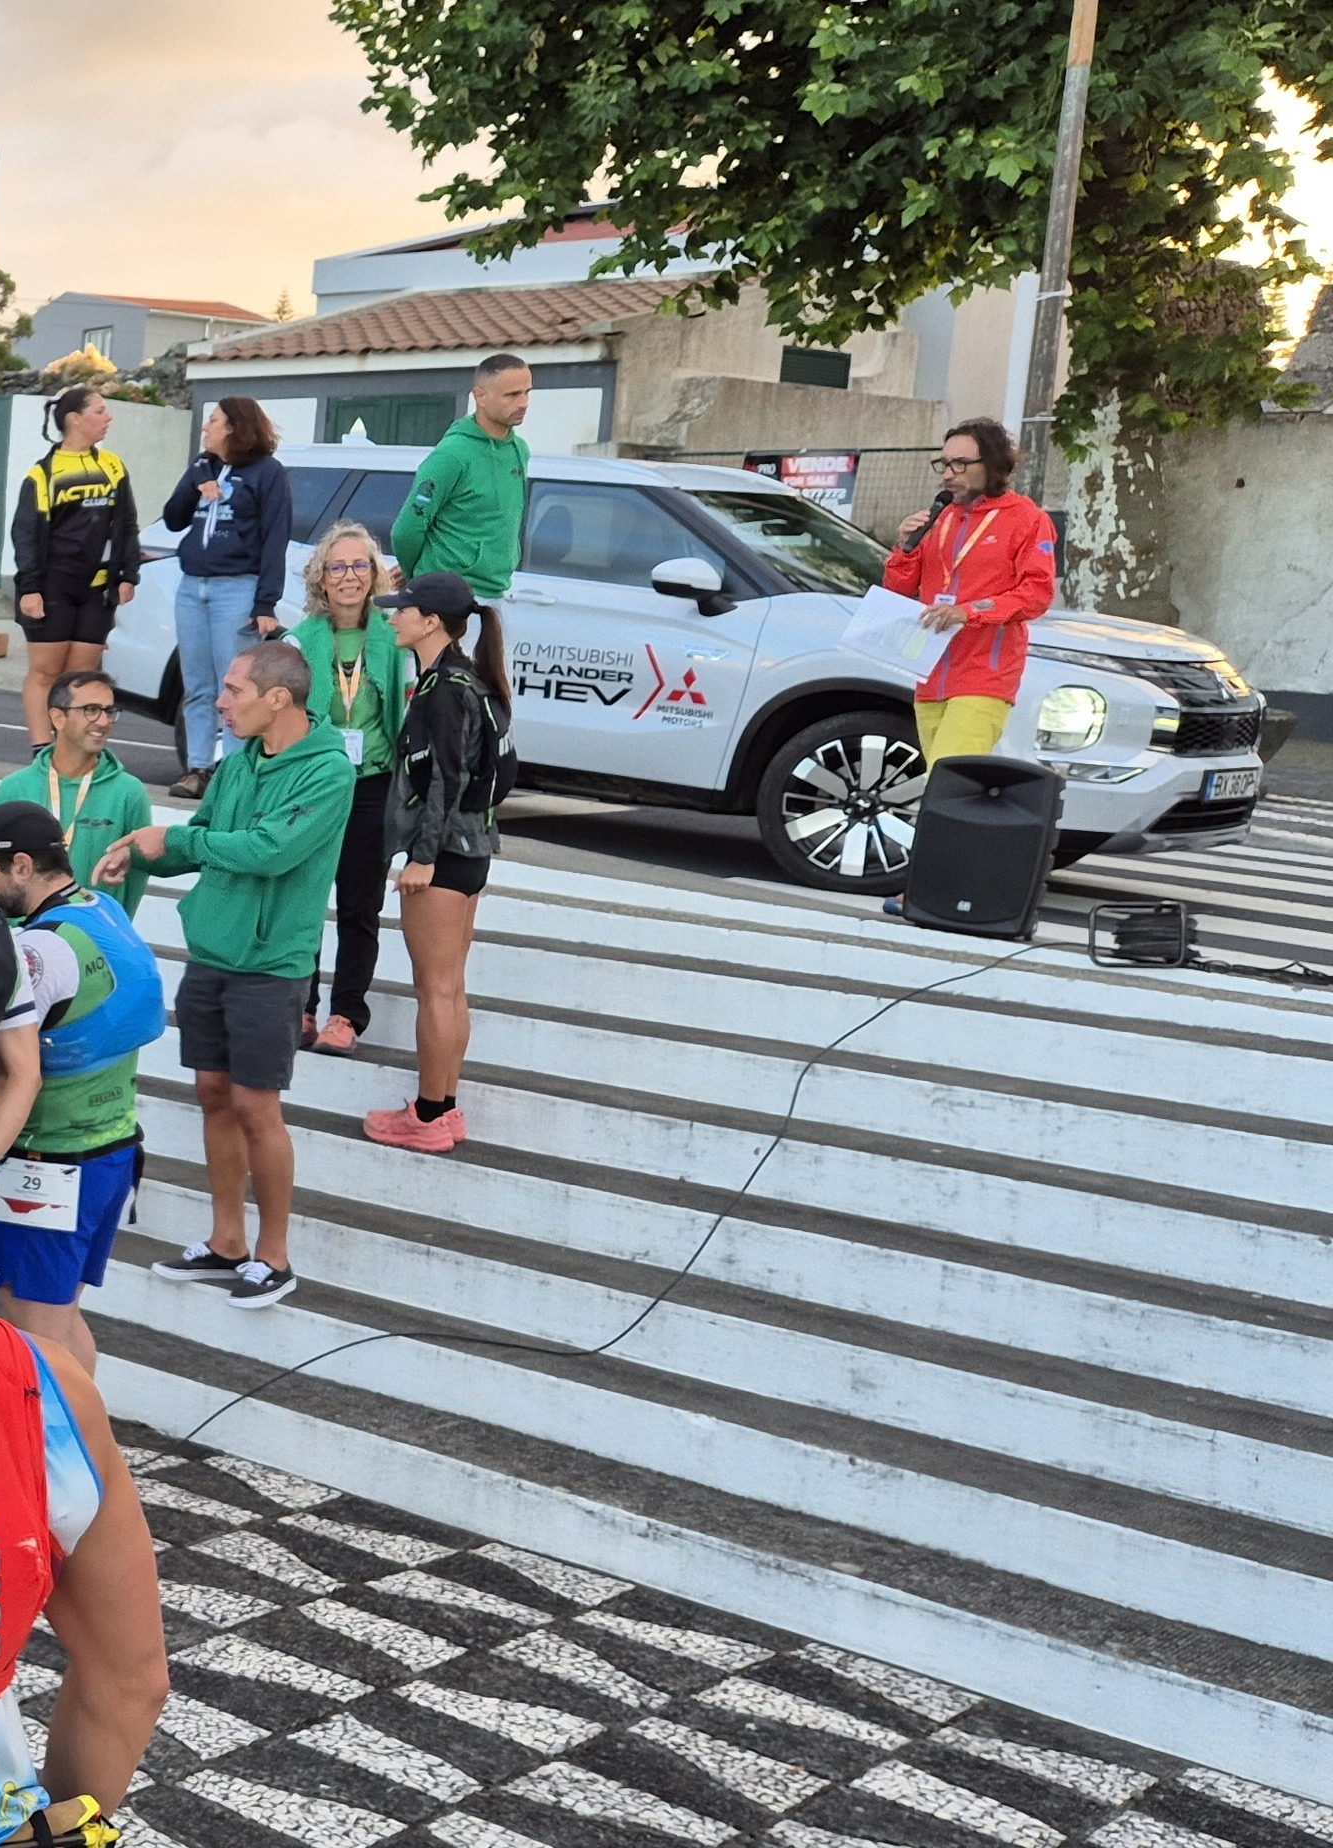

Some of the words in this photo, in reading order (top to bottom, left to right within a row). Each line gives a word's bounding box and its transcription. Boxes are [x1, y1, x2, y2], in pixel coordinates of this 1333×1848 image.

[788, 457, 849, 473] VENDE
[536, 643, 634, 668] MITSUBISHI
[656, 704, 715, 720] MITSUBISHI
[661, 713, 705, 729] MOTORS
[22, 1175, 42, 1190] 29
